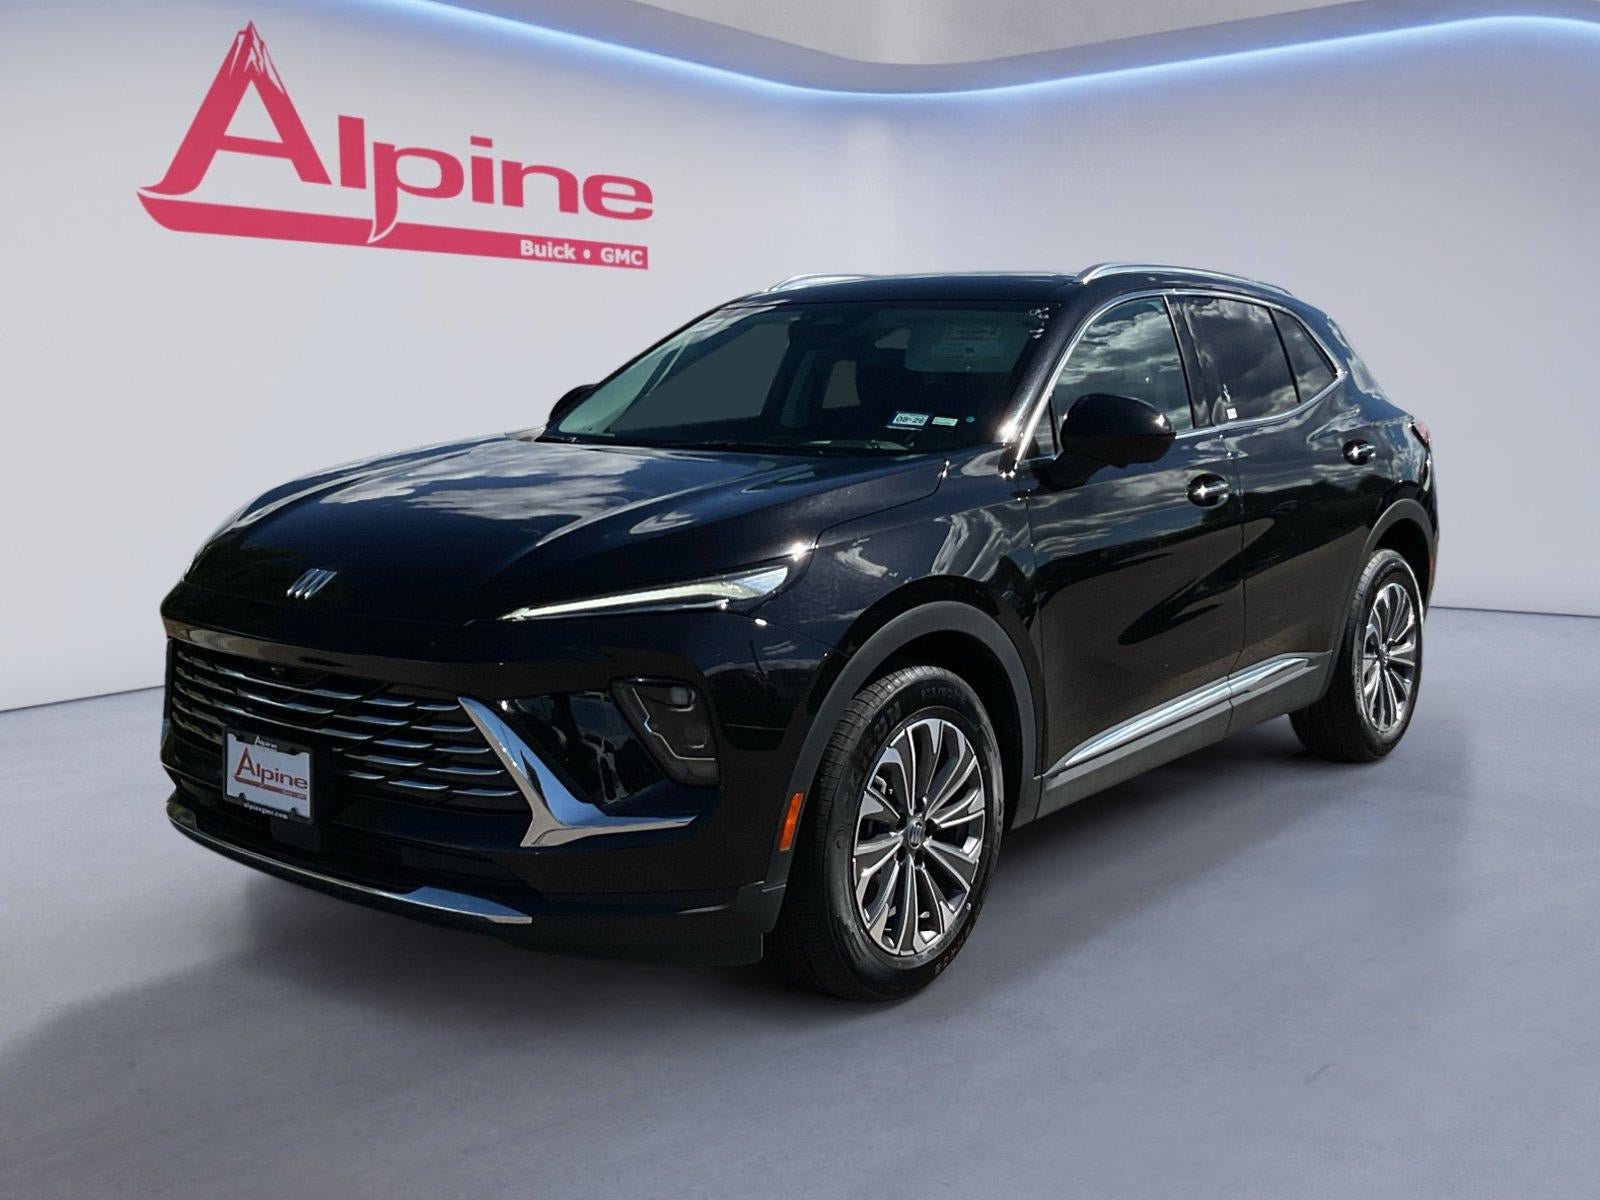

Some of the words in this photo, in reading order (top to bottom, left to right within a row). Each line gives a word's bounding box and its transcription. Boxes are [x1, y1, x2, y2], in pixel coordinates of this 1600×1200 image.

[138, 20, 653, 245] Alpine
[520, 240, 577, 261] Buick
[600, 247, 644, 266] GMC
[235, 746, 308, 789] Alpine
